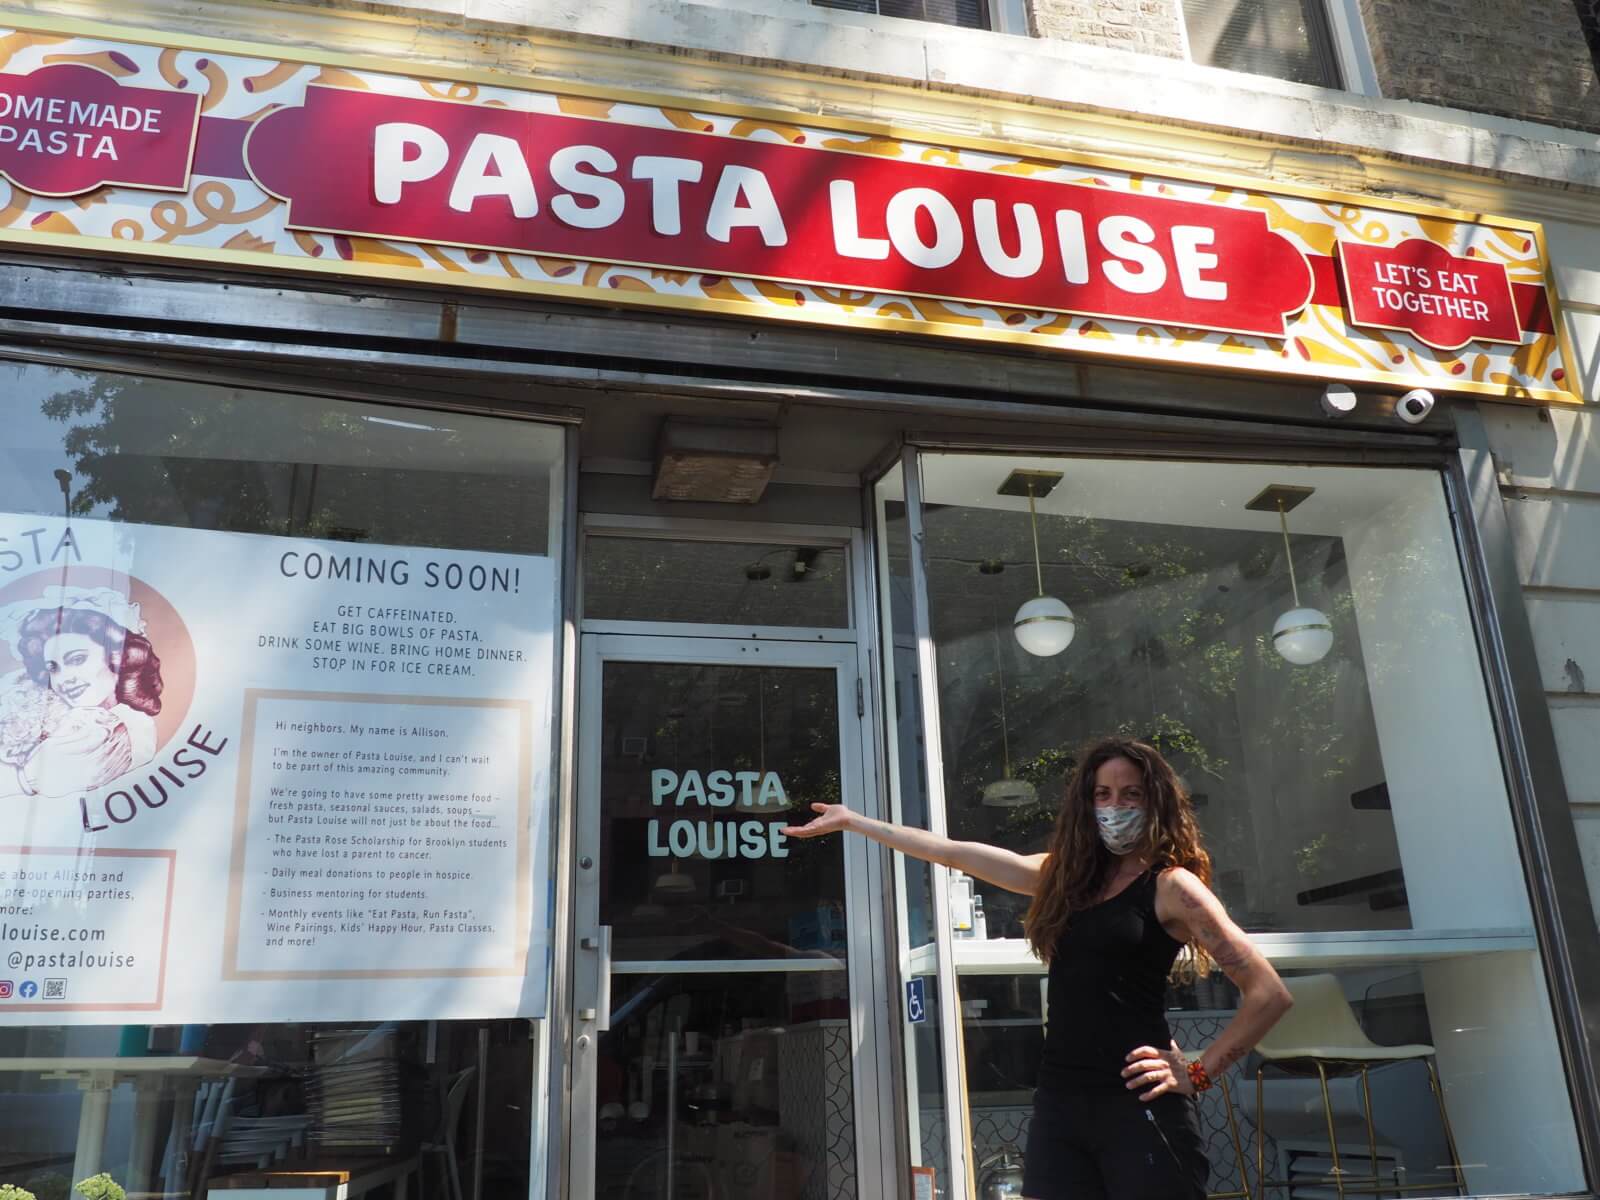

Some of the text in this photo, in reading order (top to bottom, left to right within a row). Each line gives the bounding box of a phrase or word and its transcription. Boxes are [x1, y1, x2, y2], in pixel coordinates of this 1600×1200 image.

[0, 125, 119, 161] PASTA
[374, 122, 1228, 301] PASTA LOUISE
[1374, 261, 1479, 295] LET'S EAT
[1372, 287, 1491, 321] TOGETHER
[280, 551, 520, 594] COMING SOON!
[337, 605, 457, 624] GET CAFFEINATED.
[313, 621, 484, 642] EAT BIG BOWLS OF PASTA.
[258, 635, 527, 662] DRINK SOME WINE. BRING HOME DINNER.
[313, 657, 476, 677] STOP IN FOR ICE CREAM.
[276, 721, 448, 738] Hi neighbors. My name is Allison.
[273, 747, 288, 756] I'm
[292, 749, 307, 758] the
[311, 751, 339, 759] owner
[342, 751, 352, 759] of
[355, 751, 380, 761] Pasta
[419, 754, 436, 762] and
[446, 754, 468, 764] can't
[471, 755, 489, 764] wait
[80, 723, 229, 832] LOUISE
[273, 762, 450, 777] to be part of this amazing community.
[270, 787, 298, 797] We're
[301, 789, 327, 799] going
[331, 790, 340, 798] to
[344, 790, 365, 799] have
[396, 793, 424, 802] pretty
[427, 794, 468, 802] awesome
[471, 793, 492, 802] food
[651, 768, 786, 807] PASTA
[269, 800, 294, 810] fresh
[330, 803, 371, 812] seasonal
[447, 806, 472, 816] soups
[268, 814, 283, 824] but
[287, 814, 313, 824] Pasta
[317, 815, 348, 825] Louise
[350, 816, 368, 825] will
[371, 817, 386, 826] not
[389, 817, 407, 828] just
[411, 817, 421, 827] be
[425, 818, 450, 827] about
[454, 819, 468, 827] the
[274, 834, 508, 848] The Pasta Rose Scholarship for Brooklyn students
[647, 819, 789, 859] LOUISE
[272, 848, 292, 857] who
[296, 848, 317, 857] have
[321, 849, 339, 858] lost
[351, 850, 382, 860] parent
[386, 851, 395, 859] to
[12, 869, 48, 881] about
[54, 870, 96, 882] Allison
[101, 871, 124, 882] and
[271, 867, 296, 879] Daily
[299, 869, 322, 877] meal
[326, 868, 372, 878] donations
[376, 870, 385, 879] to
[389, 870, 421, 880] people
[424, 870, 432, 879] in
[5, 888, 135, 901] pre-opening parties,
[270, 888, 313, 898] Business
[316, 889, 364, 900] mentoring
[368, 889, 381, 898] for
[268, 909, 307, 920] Monthly
[311, 910, 342, 919] events
[346, 909, 364, 919] like
[423, 910, 440, 919] Run
[2, 923, 106, 942] louise.com
[267, 922, 290, 932] Wine
[294, 922, 337, 935] Pairings,
[368, 923, 397, 934] Happy
[429, 923, 454, 933] Pasta
[265, 937, 316, 946] and more!
[7, 951, 135, 972] @pastalouise
